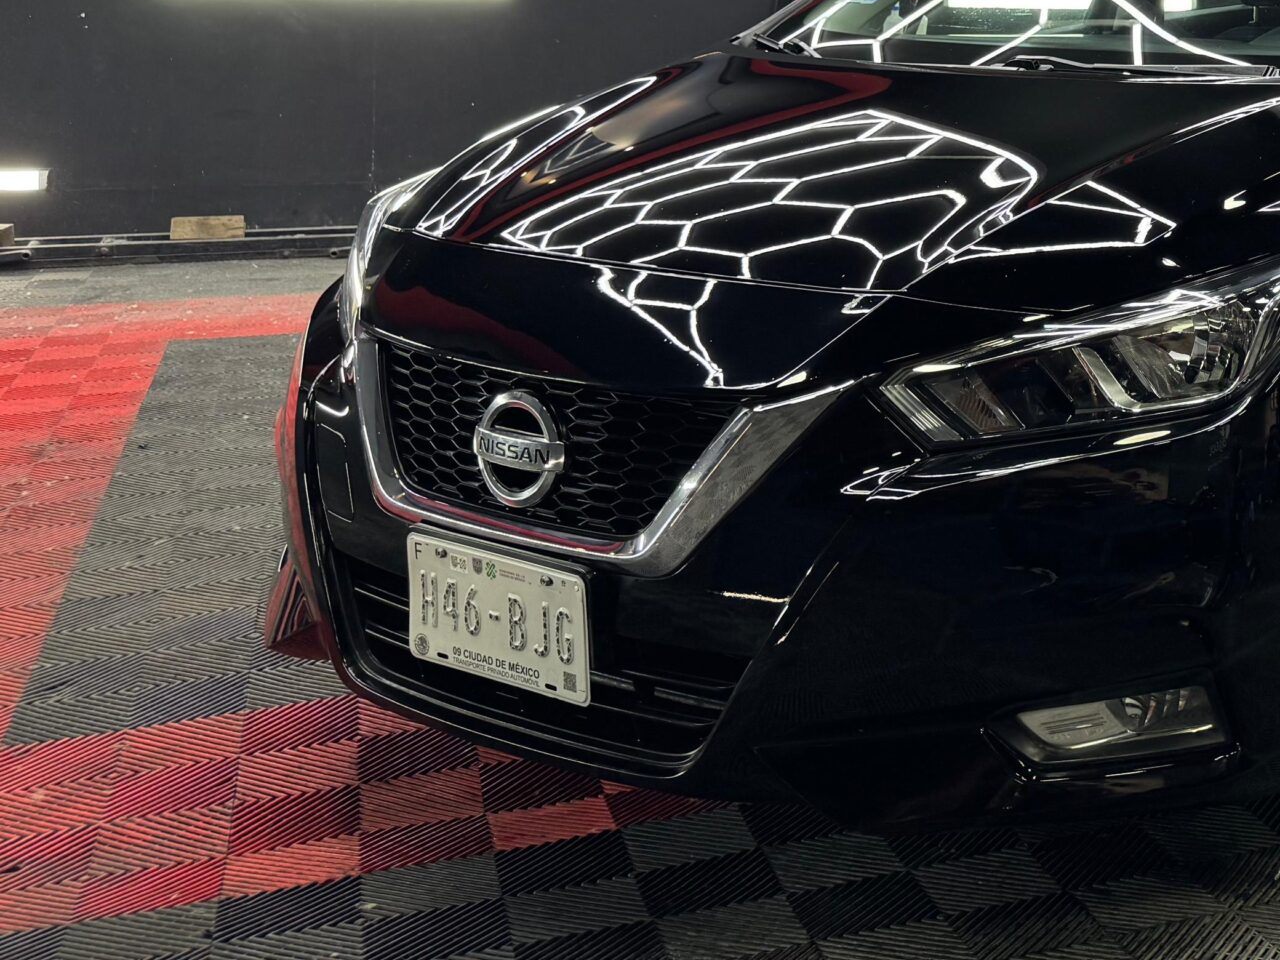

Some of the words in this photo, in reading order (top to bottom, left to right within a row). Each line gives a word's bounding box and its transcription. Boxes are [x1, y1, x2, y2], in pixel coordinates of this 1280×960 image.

[480, 435, 551, 465] NISSAN
[452, 646, 462, 657] 09
[463, 649, 494, 666] CIUDAD
[495, 658, 507, 670] DE
[508, 662, 540, 680] MÉXICO
[452, 656, 487, 672] TRANSPORTE
[486, 666, 510, 679] PRIVADO
[509, 673, 541, 688] AUTOMÓVIL
